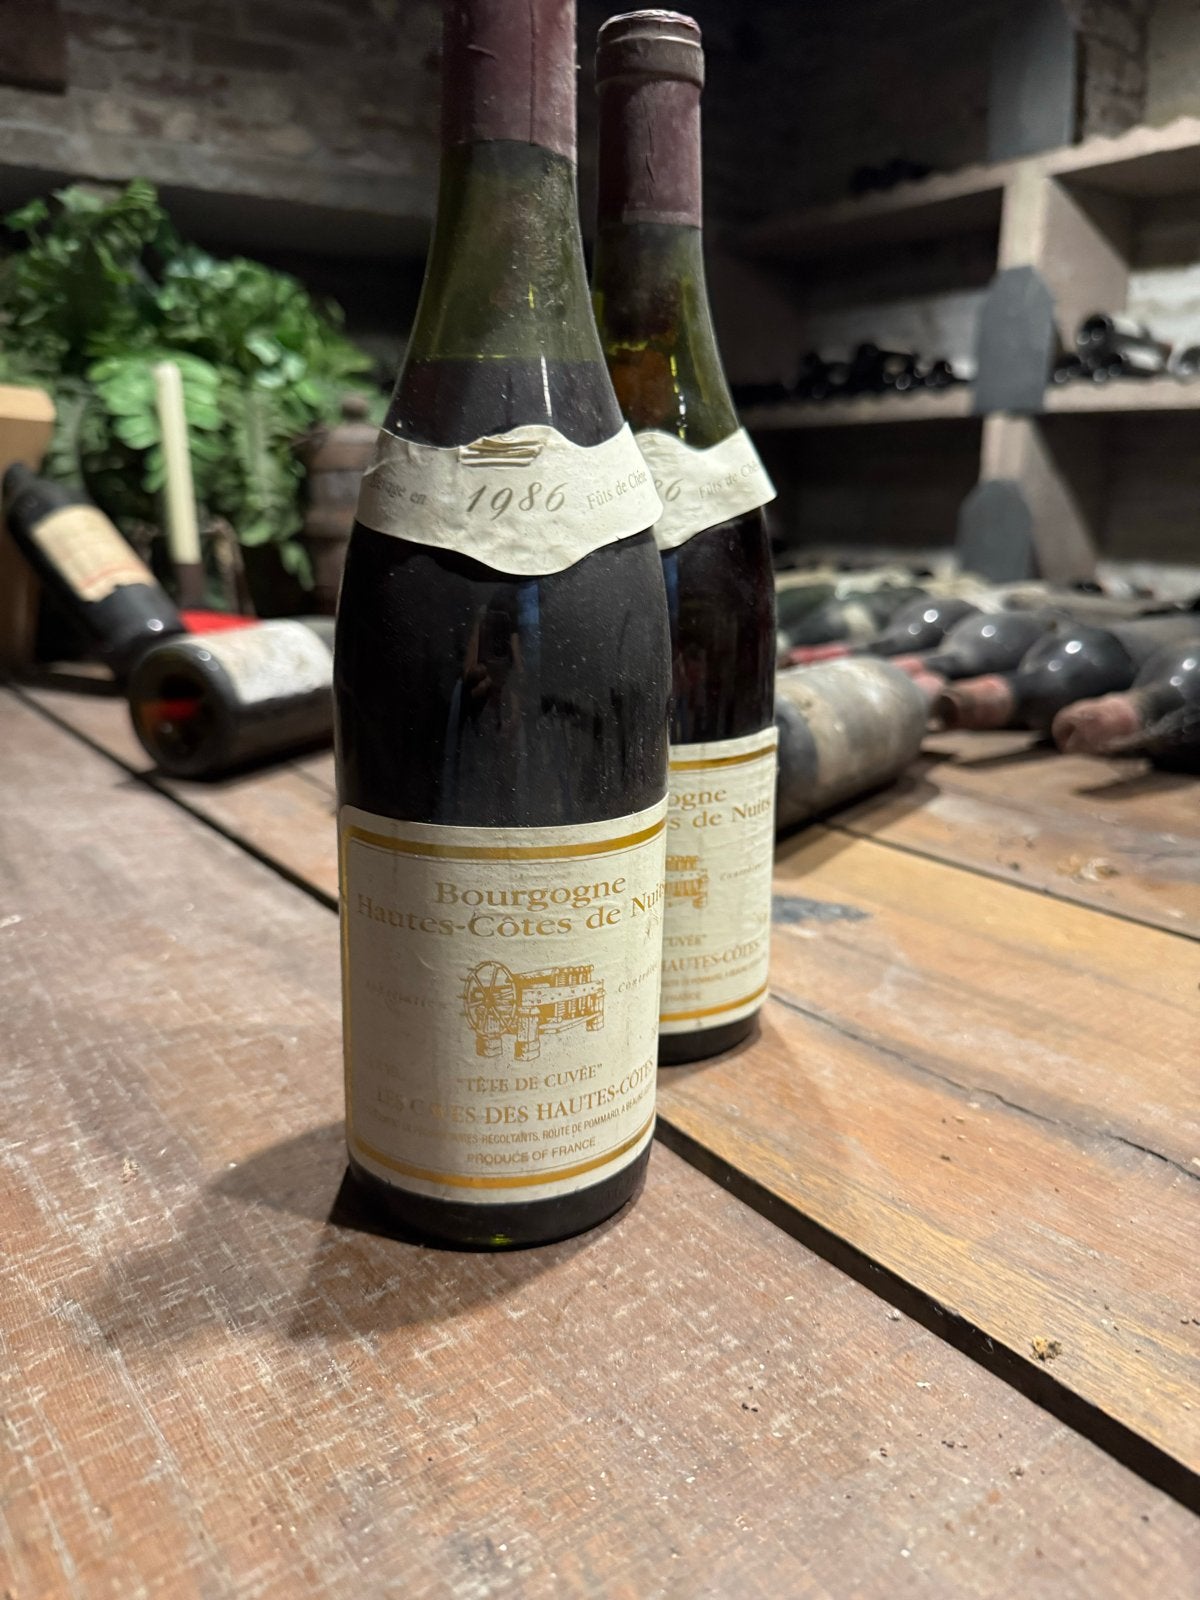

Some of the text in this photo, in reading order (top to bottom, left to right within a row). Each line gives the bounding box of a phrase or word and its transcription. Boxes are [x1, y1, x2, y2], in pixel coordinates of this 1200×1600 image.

[466, 482, 569, 520] 1986
[616, 480, 627, 496] de
[692, 810, 722, 828] de
[731, 798, 771, 823] Nuits
[435, 877, 626, 912] Bourgogne
[357, 892, 573, 938] Hautes-Côtes
[586, 906, 621, 930] de
[515, 1077, 538, 1091] DE
[485, 1105, 529, 1125] DES
[542, 1124, 571, 1140] ROUTE
[572, 1122, 583, 1134] DE
[467, 1137, 596, 1166] PRODUCE OF FRANCE
